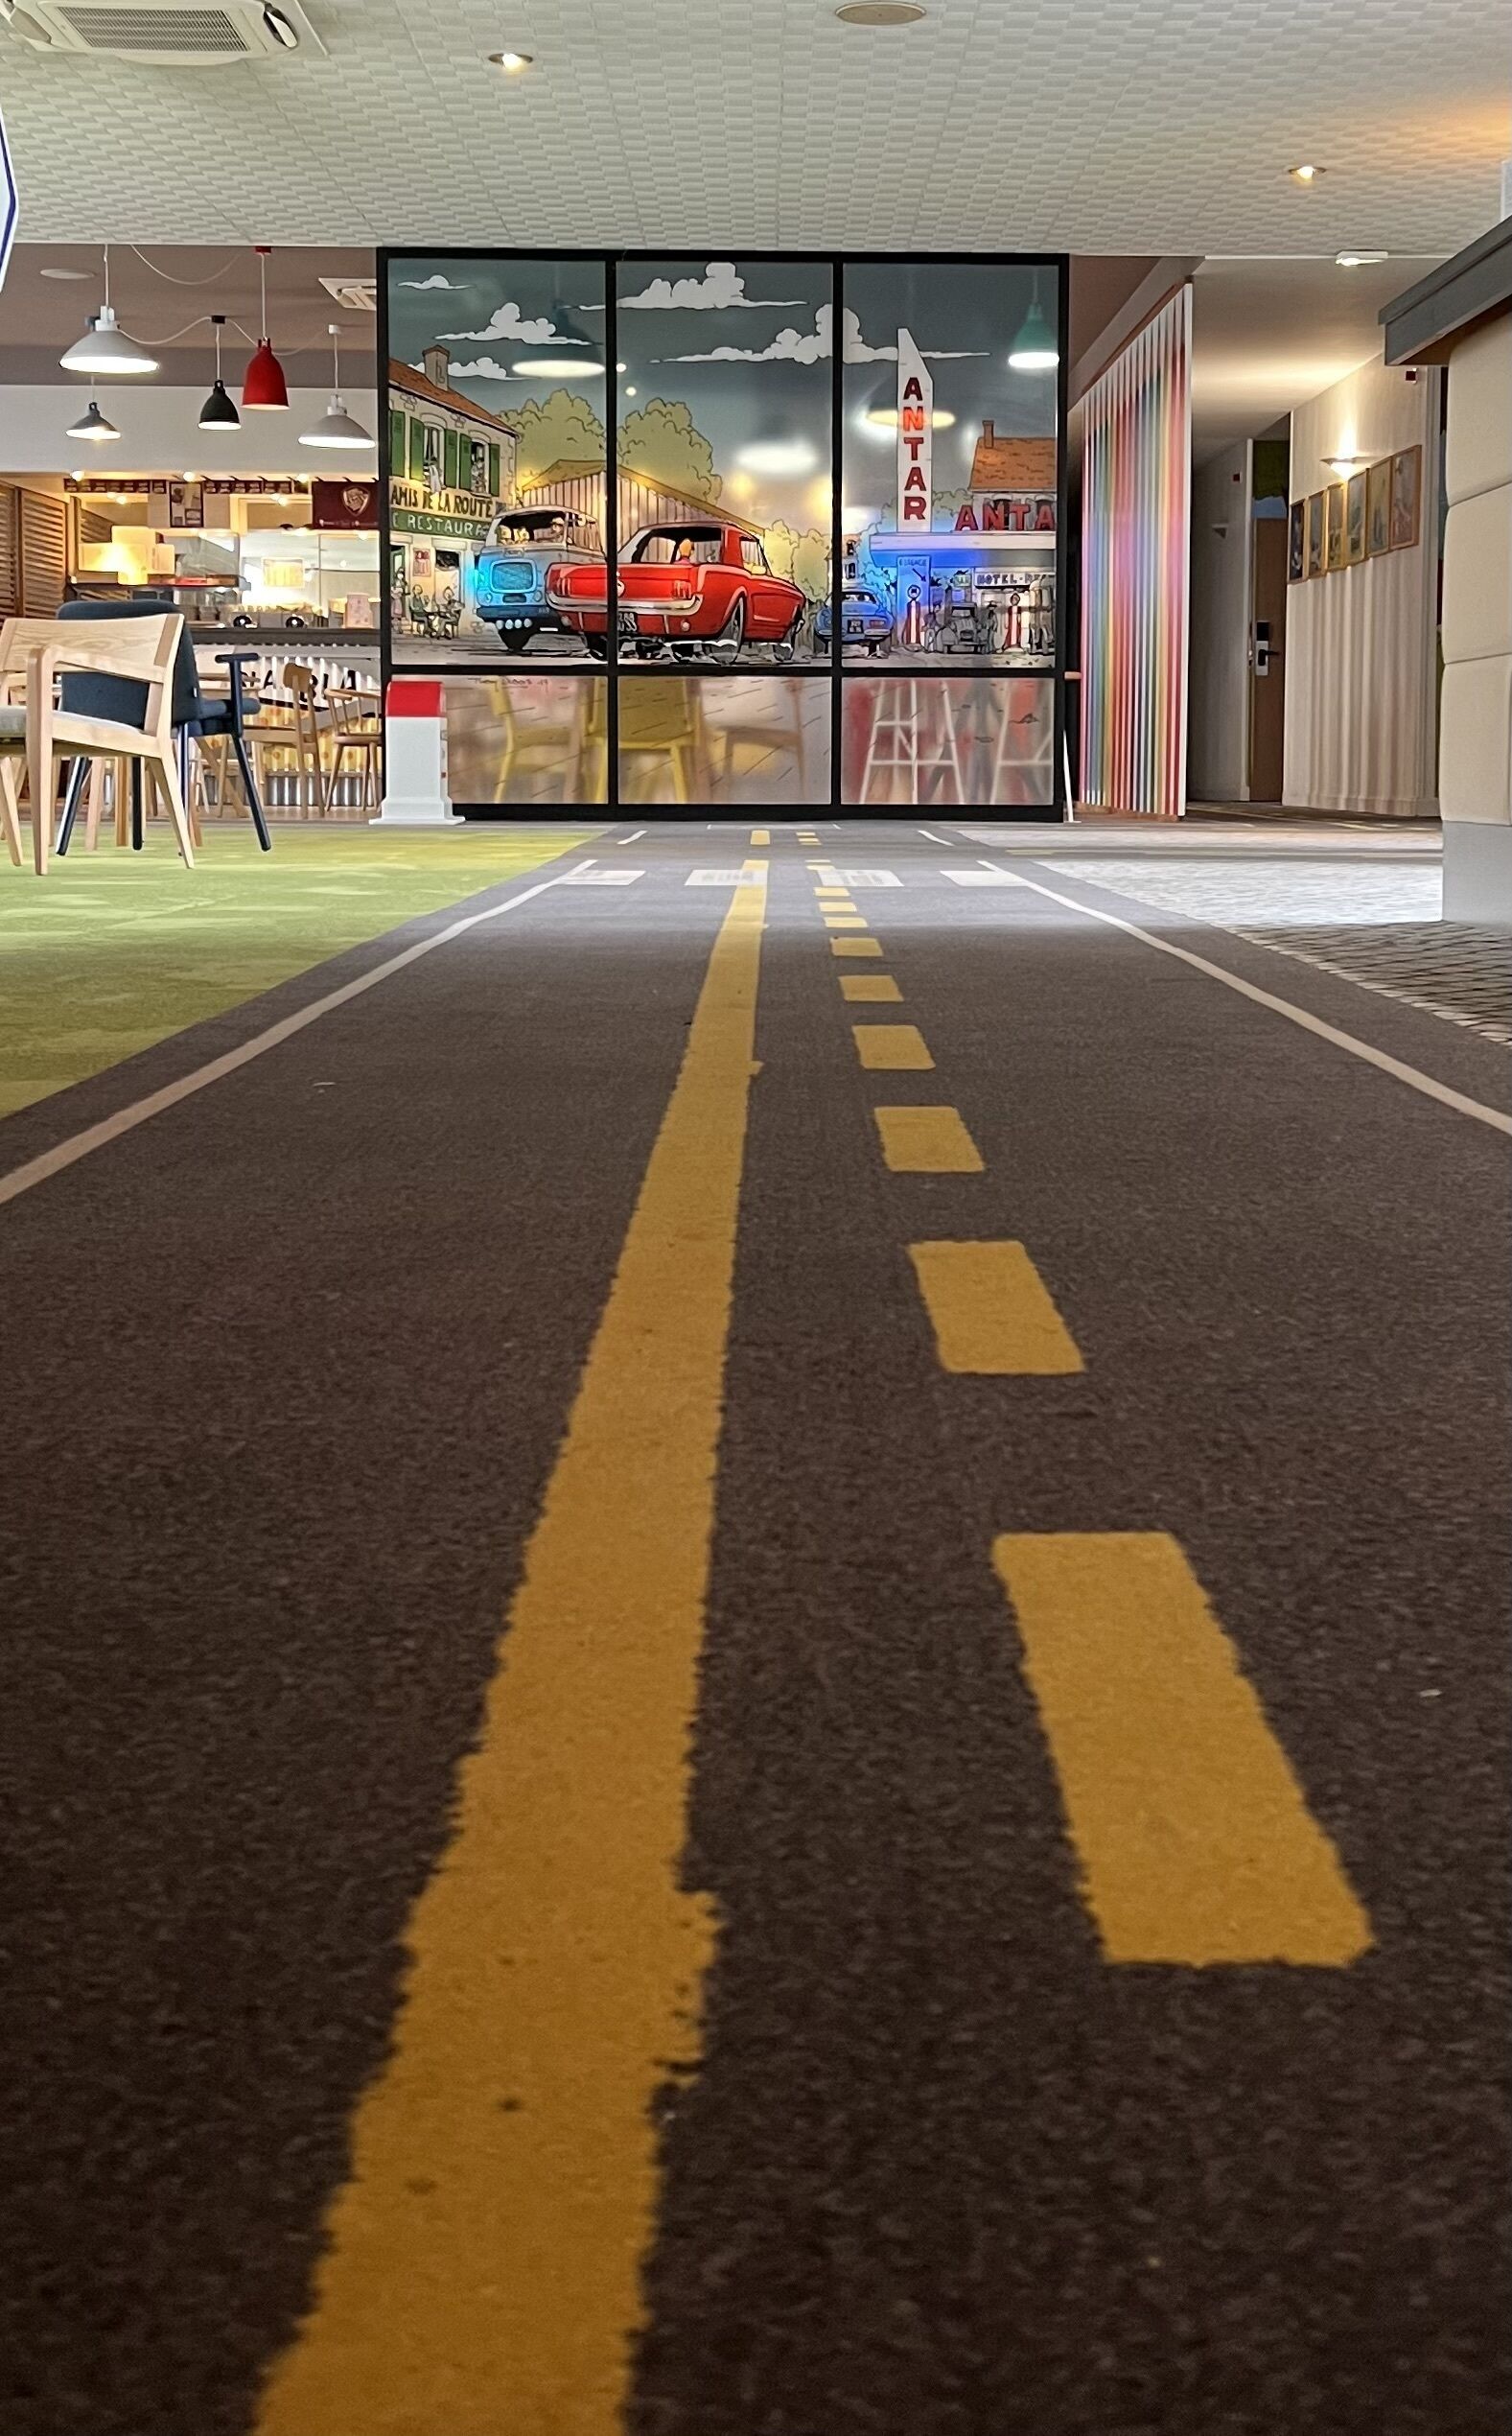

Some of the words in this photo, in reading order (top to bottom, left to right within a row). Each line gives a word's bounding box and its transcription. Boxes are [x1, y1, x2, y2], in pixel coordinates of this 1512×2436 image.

[903, 377, 927, 520] ANTAR
[391, 484, 418, 507] AMIS
[438, 490, 451, 513] LA
[454, 495, 493, 518] ROUTE
[954, 504, 1055, 531] ANTA
